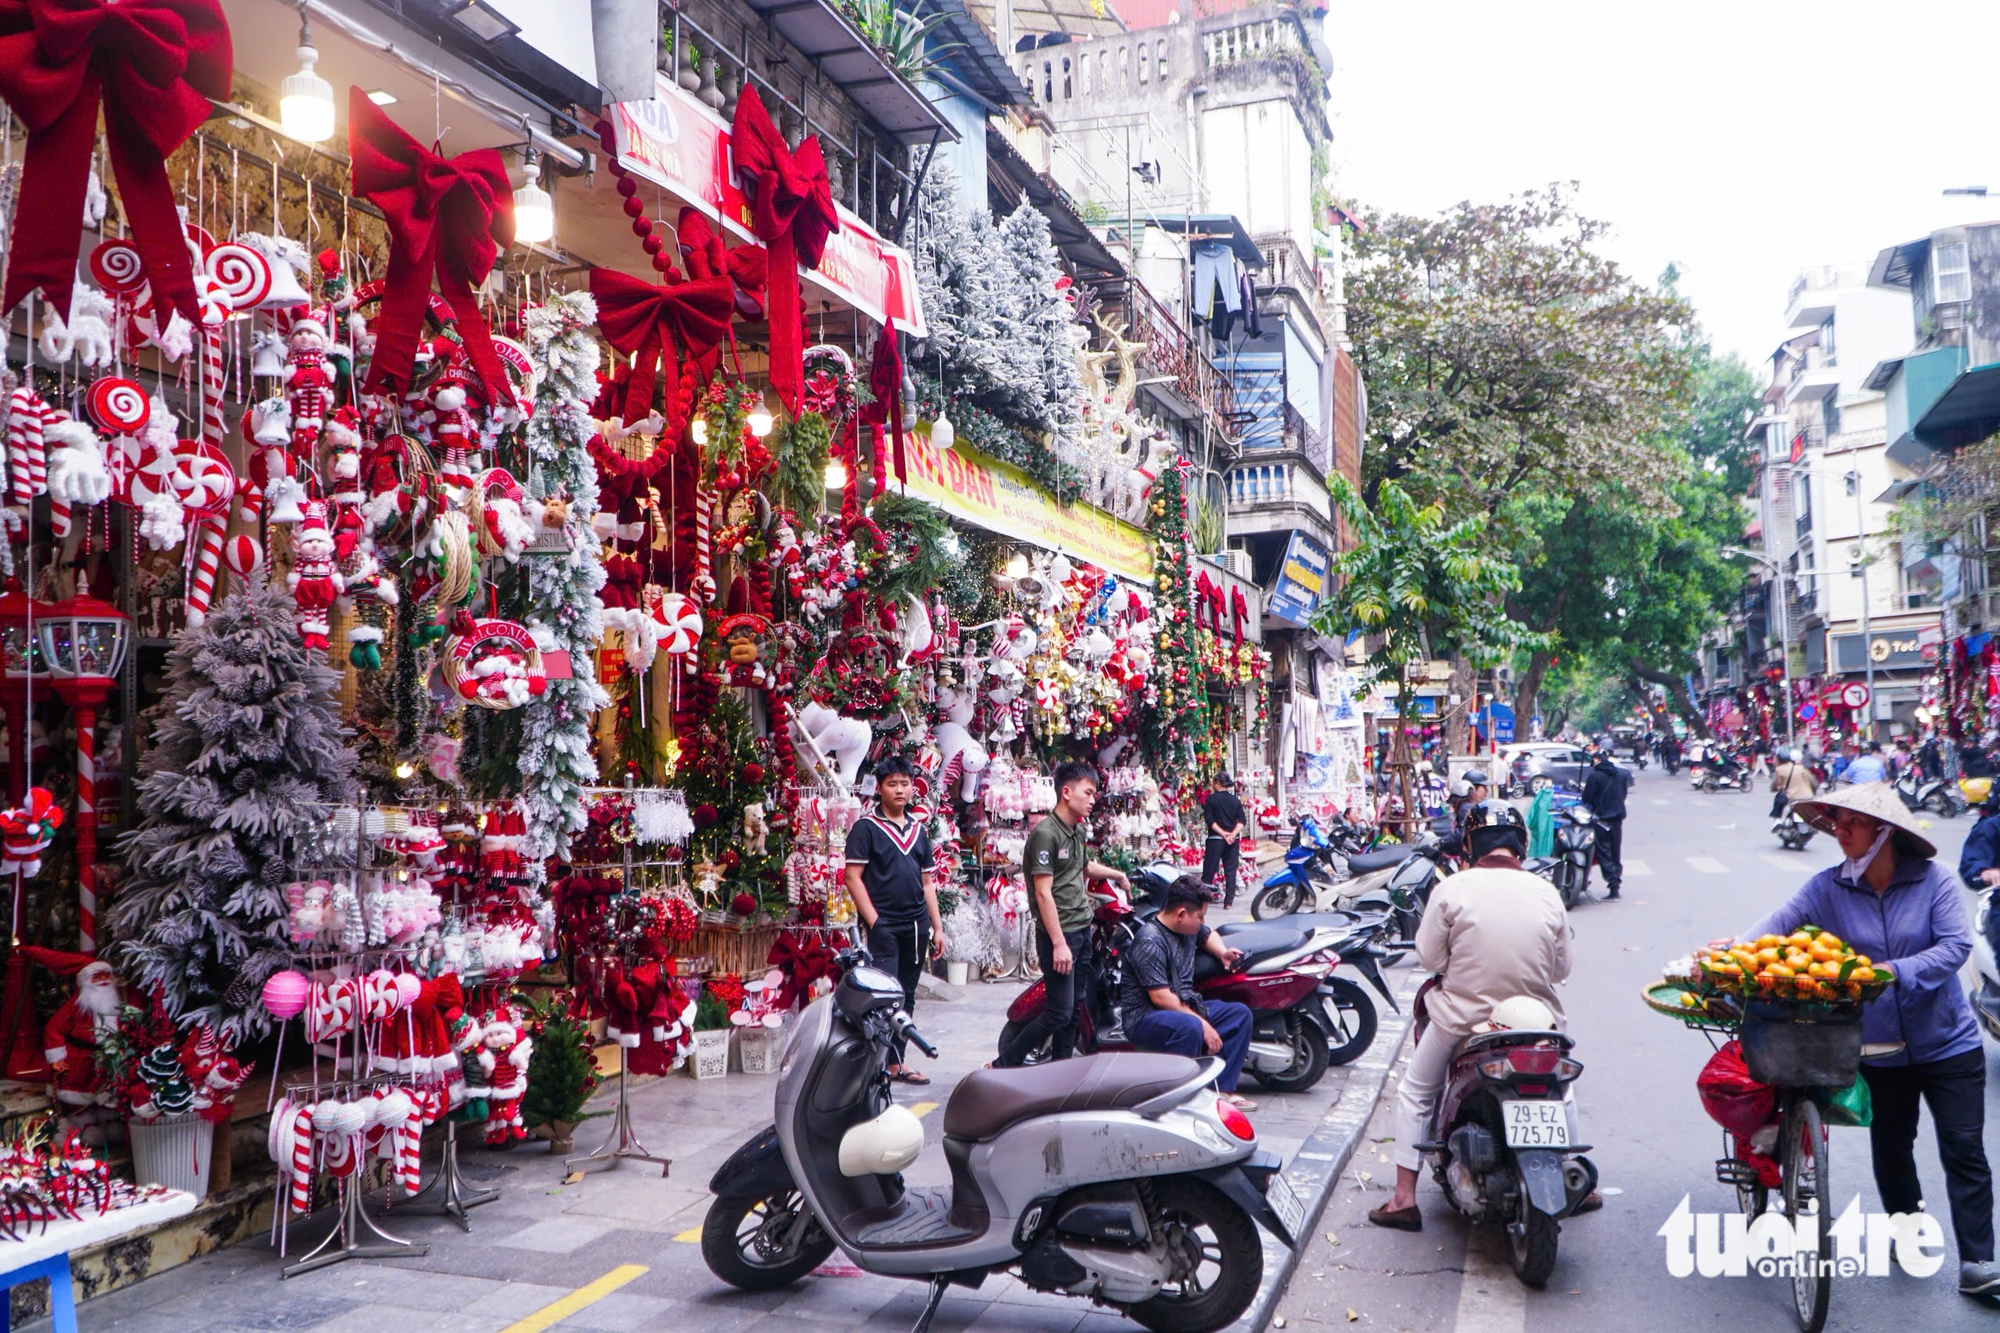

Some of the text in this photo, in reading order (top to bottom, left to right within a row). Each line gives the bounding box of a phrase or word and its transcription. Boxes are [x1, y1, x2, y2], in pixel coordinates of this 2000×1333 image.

[458, 625, 528, 652] WELCOME
[1258, 977, 1294, 987] LEAD
[1513, 1105, 1558, 1123] 29-E2
[1509, 1126, 1566, 1145] 725.79
